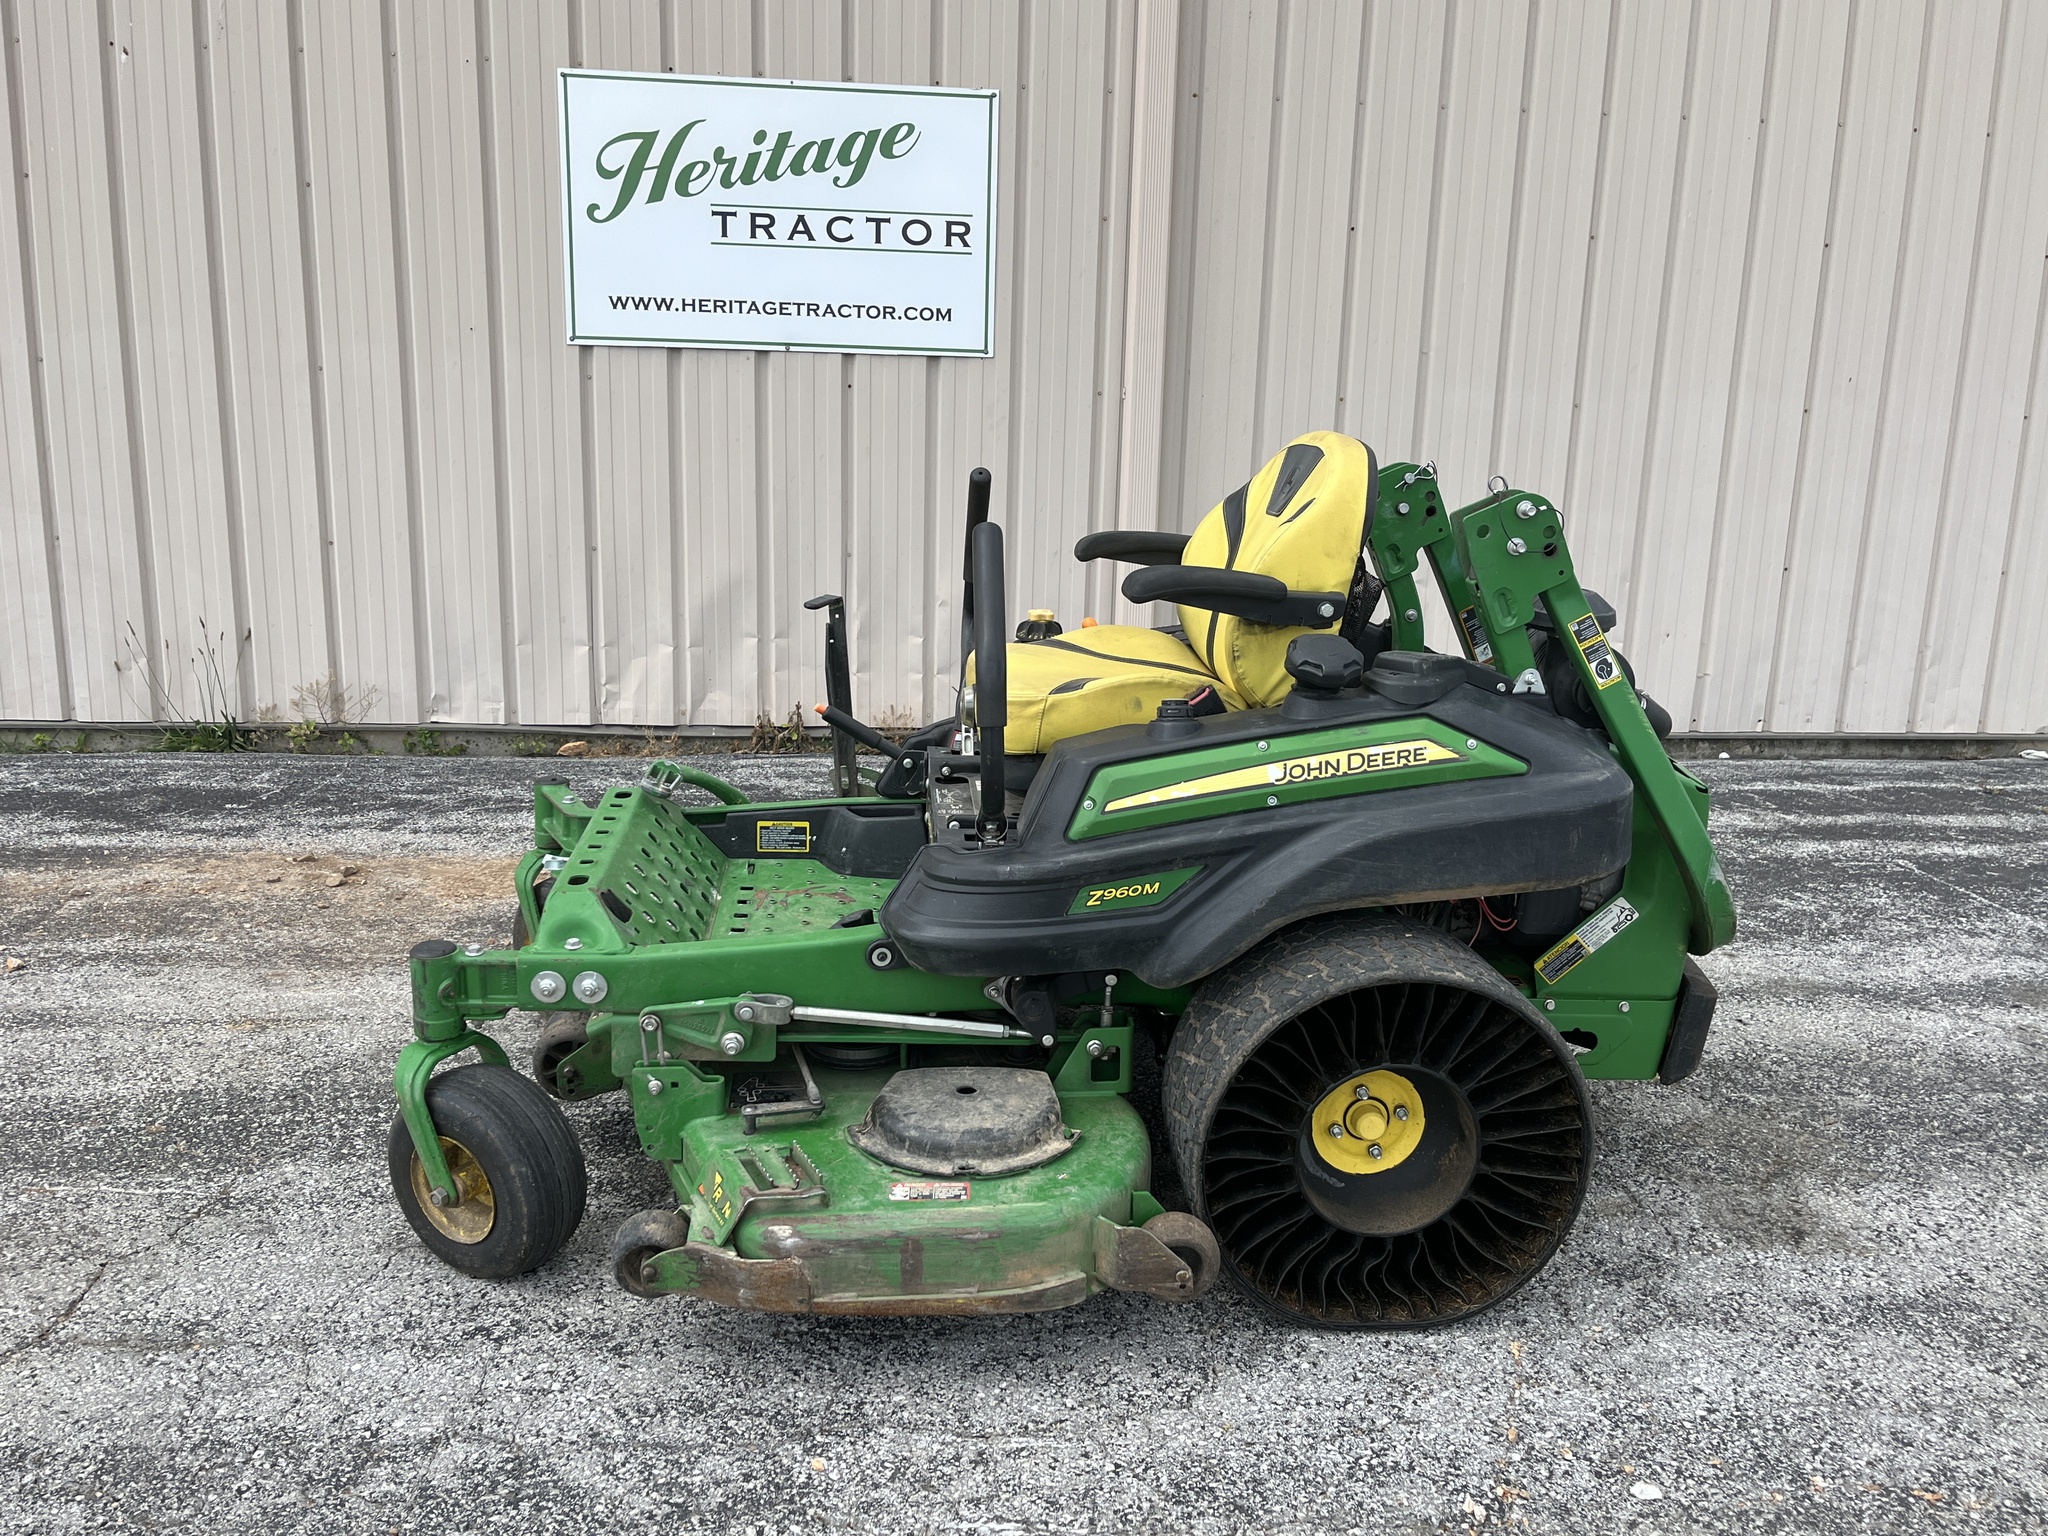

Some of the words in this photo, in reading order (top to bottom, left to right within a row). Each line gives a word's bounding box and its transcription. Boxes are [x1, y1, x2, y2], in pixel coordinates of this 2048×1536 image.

[586, 118, 921, 223] Heritage
[711, 210, 971, 248] TRACTOR
[608, 296, 953, 322] WWW.HERITAGETRACTOR.COM
[1275, 758, 1340, 783] JOHN
[1347, 747, 1427, 772] DEERE
[1086, 881, 1161, 907] Z960M
